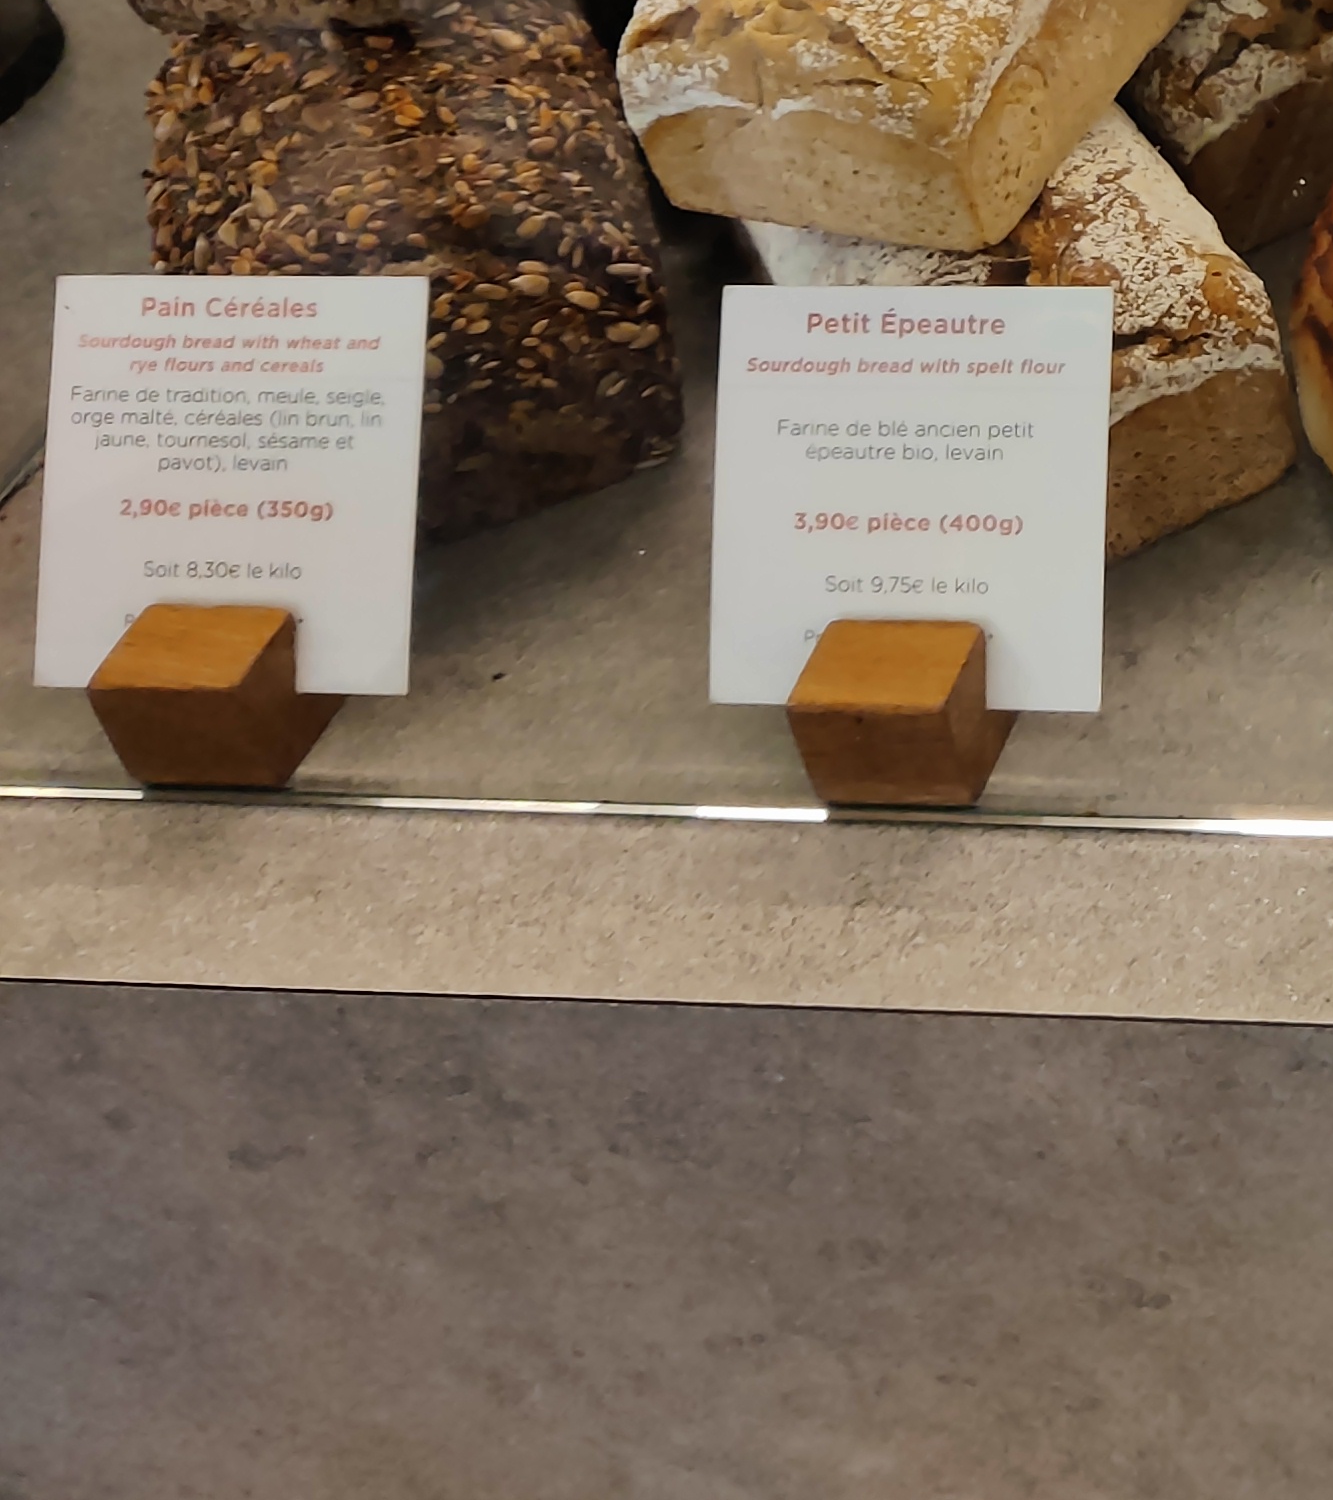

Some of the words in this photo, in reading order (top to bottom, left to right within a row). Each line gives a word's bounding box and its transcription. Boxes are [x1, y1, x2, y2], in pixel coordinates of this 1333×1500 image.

[141, 296, 196, 318] Pain
[205, 296, 318, 319] Céréales
[806, 311, 871, 334] Petit
[880, 307, 1006, 339] Épeautre
[78, 333, 177, 352] Sourdough
[181, 334, 237, 350] bread
[241, 334, 280, 350] with
[286, 335, 342, 351] wheat
[345, 335, 382, 351] and
[129, 359, 158, 375] rye
[163, 356, 215, 373] flours
[220, 358, 256, 373] and
[259, 358, 324, 374] cereals
[746, 356, 851, 376] Sourdough
[856, 357, 914, 374] bread
[919, 358, 960, 374] with
[966, 358, 1014, 378] spelt
[1020, 358, 1066, 375] flour
[70, 385, 131, 403] Farine
[135, 388, 161, 403] de
[166, 387, 251, 405] tradition,
[257, 388, 320, 406] meule,
[326, 388, 386, 409] seigle,
[70, 411, 115, 429] orge
[120, 408, 178, 427] malté,
[183, 408, 263, 427] céréales
[269, 409, 300, 429] (lin
[305, 410, 355, 428] brun,
[777, 418, 840, 438] Farine
[845, 421, 872, 438] de
[877, 420, 909, 438] blé
[914, 423, 981, 438] ancien
[987, 422, 1034, 441] petit
[94, 433, 150, 451] jaune,
[157, 431, 251, 450] tournesol,
[257, 432, 331, 450] sésame
[335, 435, 355, 451] et
[805, 444, 896, 462] épeautre
[901, 442, 938, 462] bio,
[945, 443, 1004, 461] levain
[157, 454, 227, 474] pavot),
[232, 454, 288, 472] levain
[187, 498, 249, 521] pièce
[256, 500, 334, 522] (350g)
[793, 512, 859, 534] 3,90€
[867, 512, 931, 535] pièce
[939, 514, 1024, 536] (400g)
[143, 559, 181, 579] Soit
[246, 562, 264, 580] le
[268, 562, 303, 581] kilo
[824, 574, 864, 593] Soit
[870, 575, 924, 595] 9,75€
[931, 577, 948, 595] le
[954, 577, 989, 595] kilo
